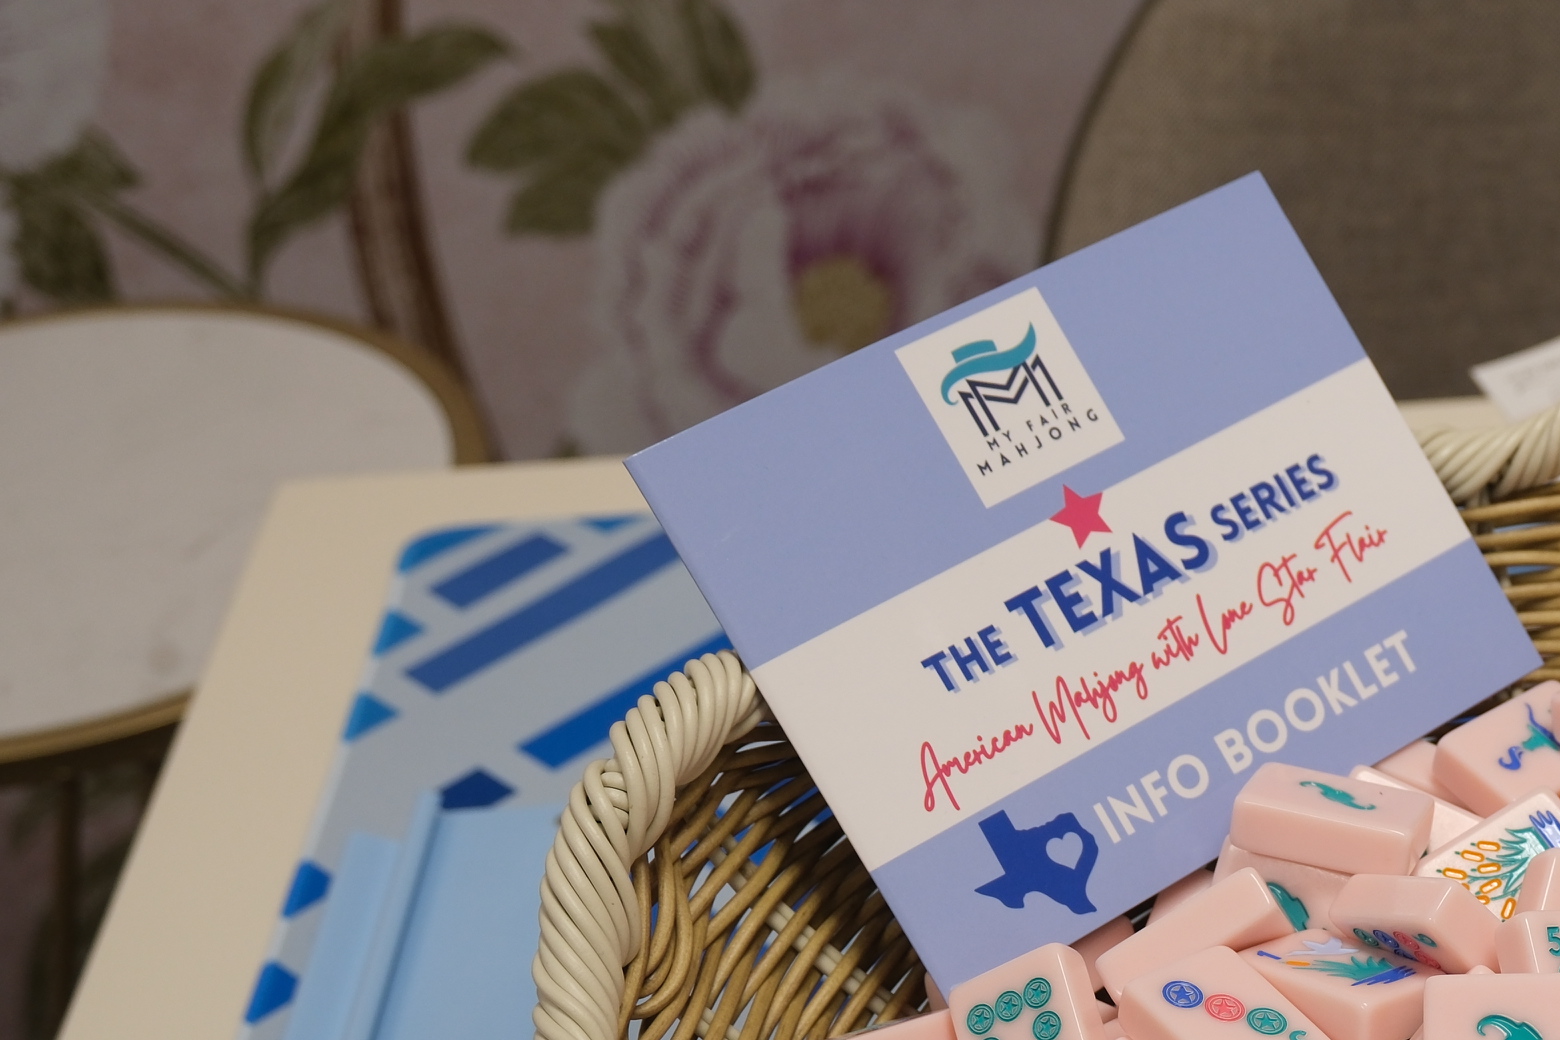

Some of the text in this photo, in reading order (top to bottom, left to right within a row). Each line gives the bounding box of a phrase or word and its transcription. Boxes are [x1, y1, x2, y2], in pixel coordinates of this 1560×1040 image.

[976, 408, 1099, 477] MAHJONG
[986, 402, 1073, 451] MY FAIR
[919, 510, 1388, 813] American Mahjong with Lone Star Flair
[920, 453, 1338, 694] THE TEXAS SERIES
[1092, 629, 1417, 844] INFO BOOKLET
